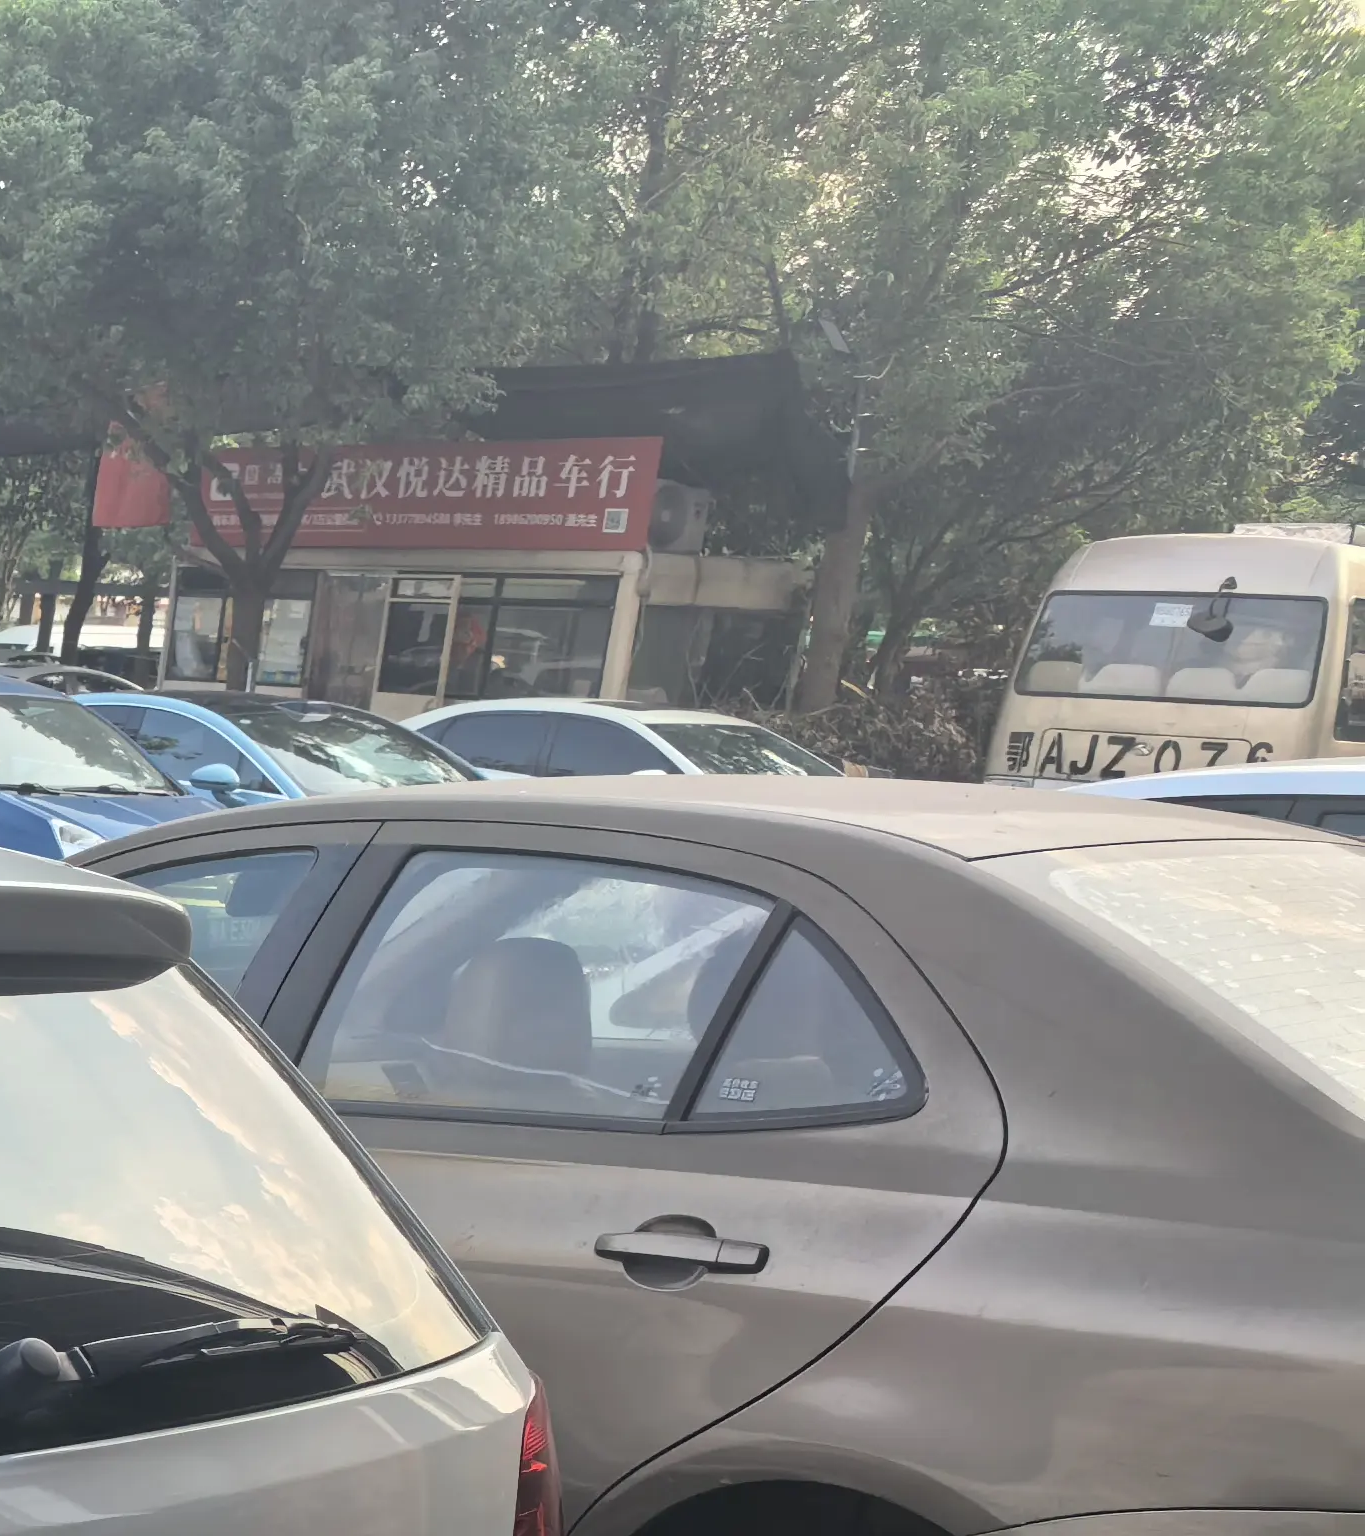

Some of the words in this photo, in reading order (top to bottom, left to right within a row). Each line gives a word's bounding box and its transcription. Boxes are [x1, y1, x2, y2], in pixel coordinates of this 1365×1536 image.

[320, 454, 637, 499] 武汉悦达精品车行
